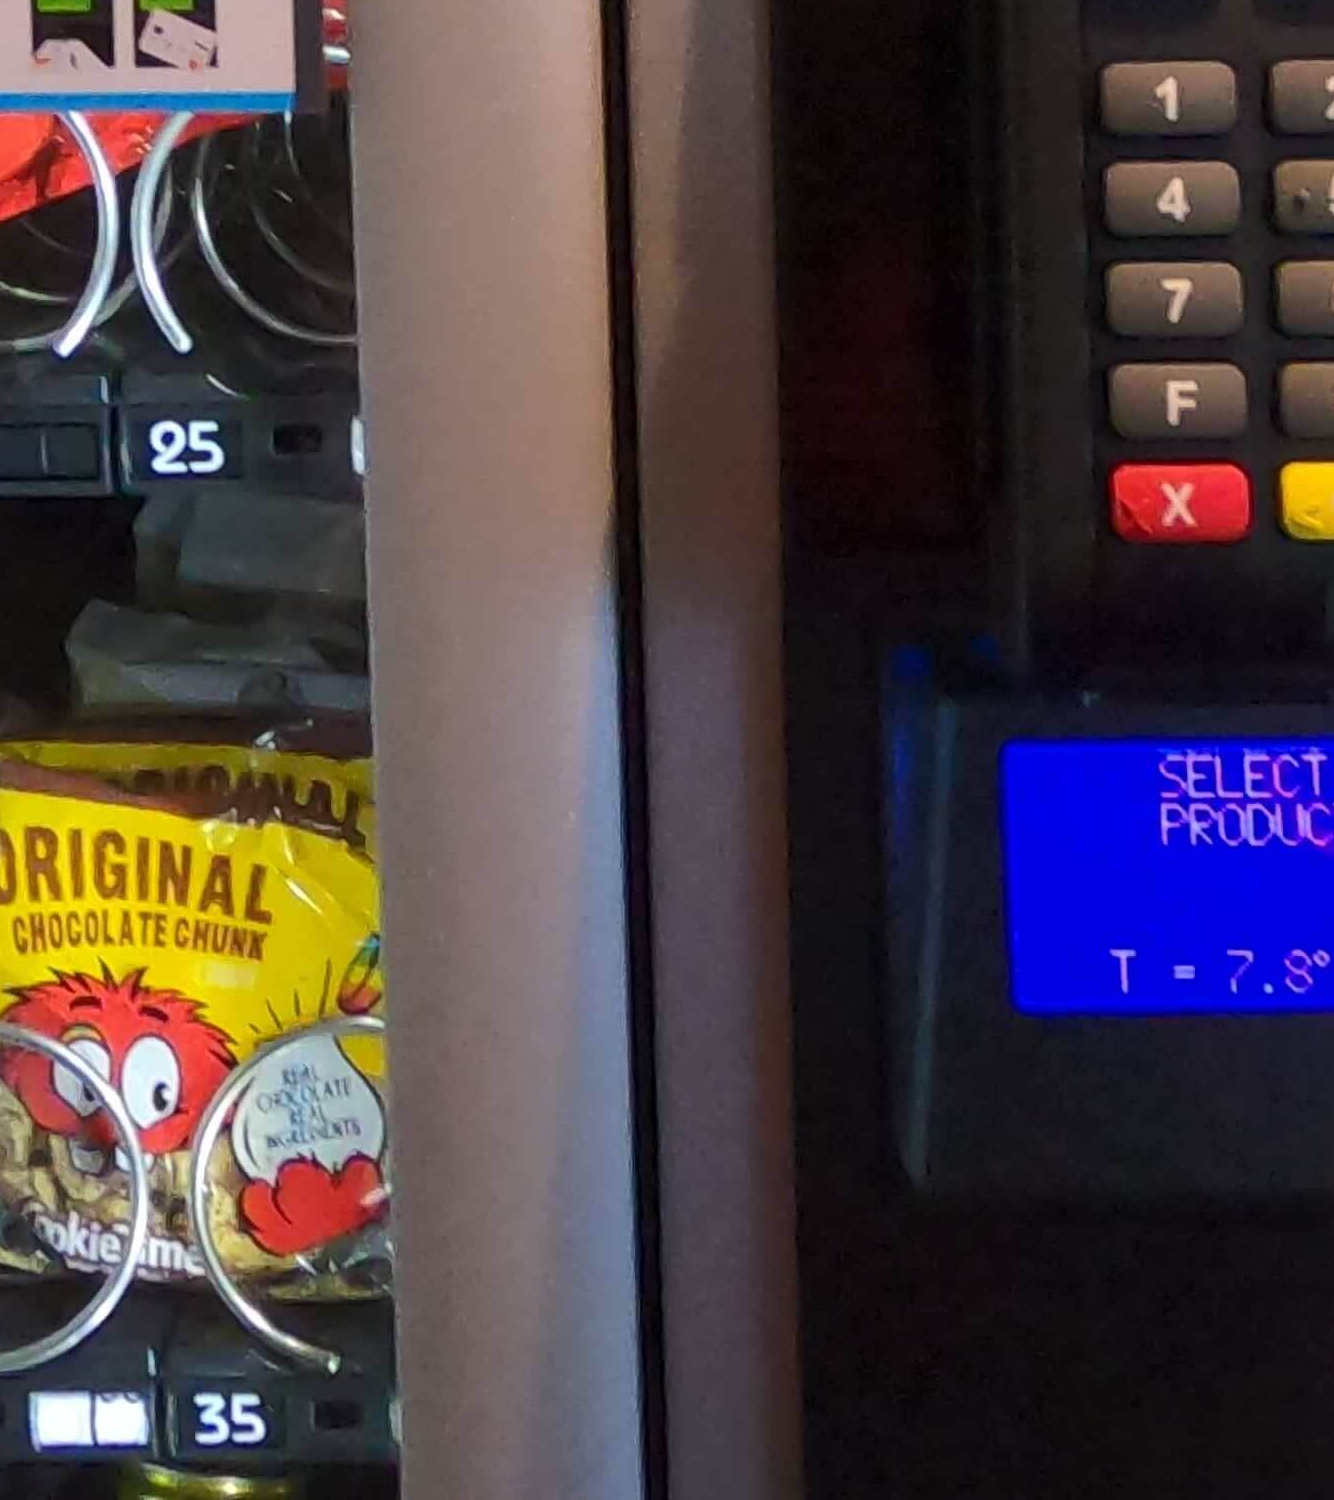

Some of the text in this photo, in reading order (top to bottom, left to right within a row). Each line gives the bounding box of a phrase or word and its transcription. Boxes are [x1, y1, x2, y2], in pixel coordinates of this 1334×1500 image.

[1155, 76, 1180, 122] 1
[1157, 177, 1190, 223] 4
[1161, 278, 1193, 325] 7
[1165, 380, 1200, 426] F
[148, 419, 226, 474] 25
[1158, 753, 1329, 799] SELECT
[12, 908, 268, 962] CHOCOLATE CHUNK
[1109, 948, 1138, 994] T
[192, 1393, 267, 1445] 35
